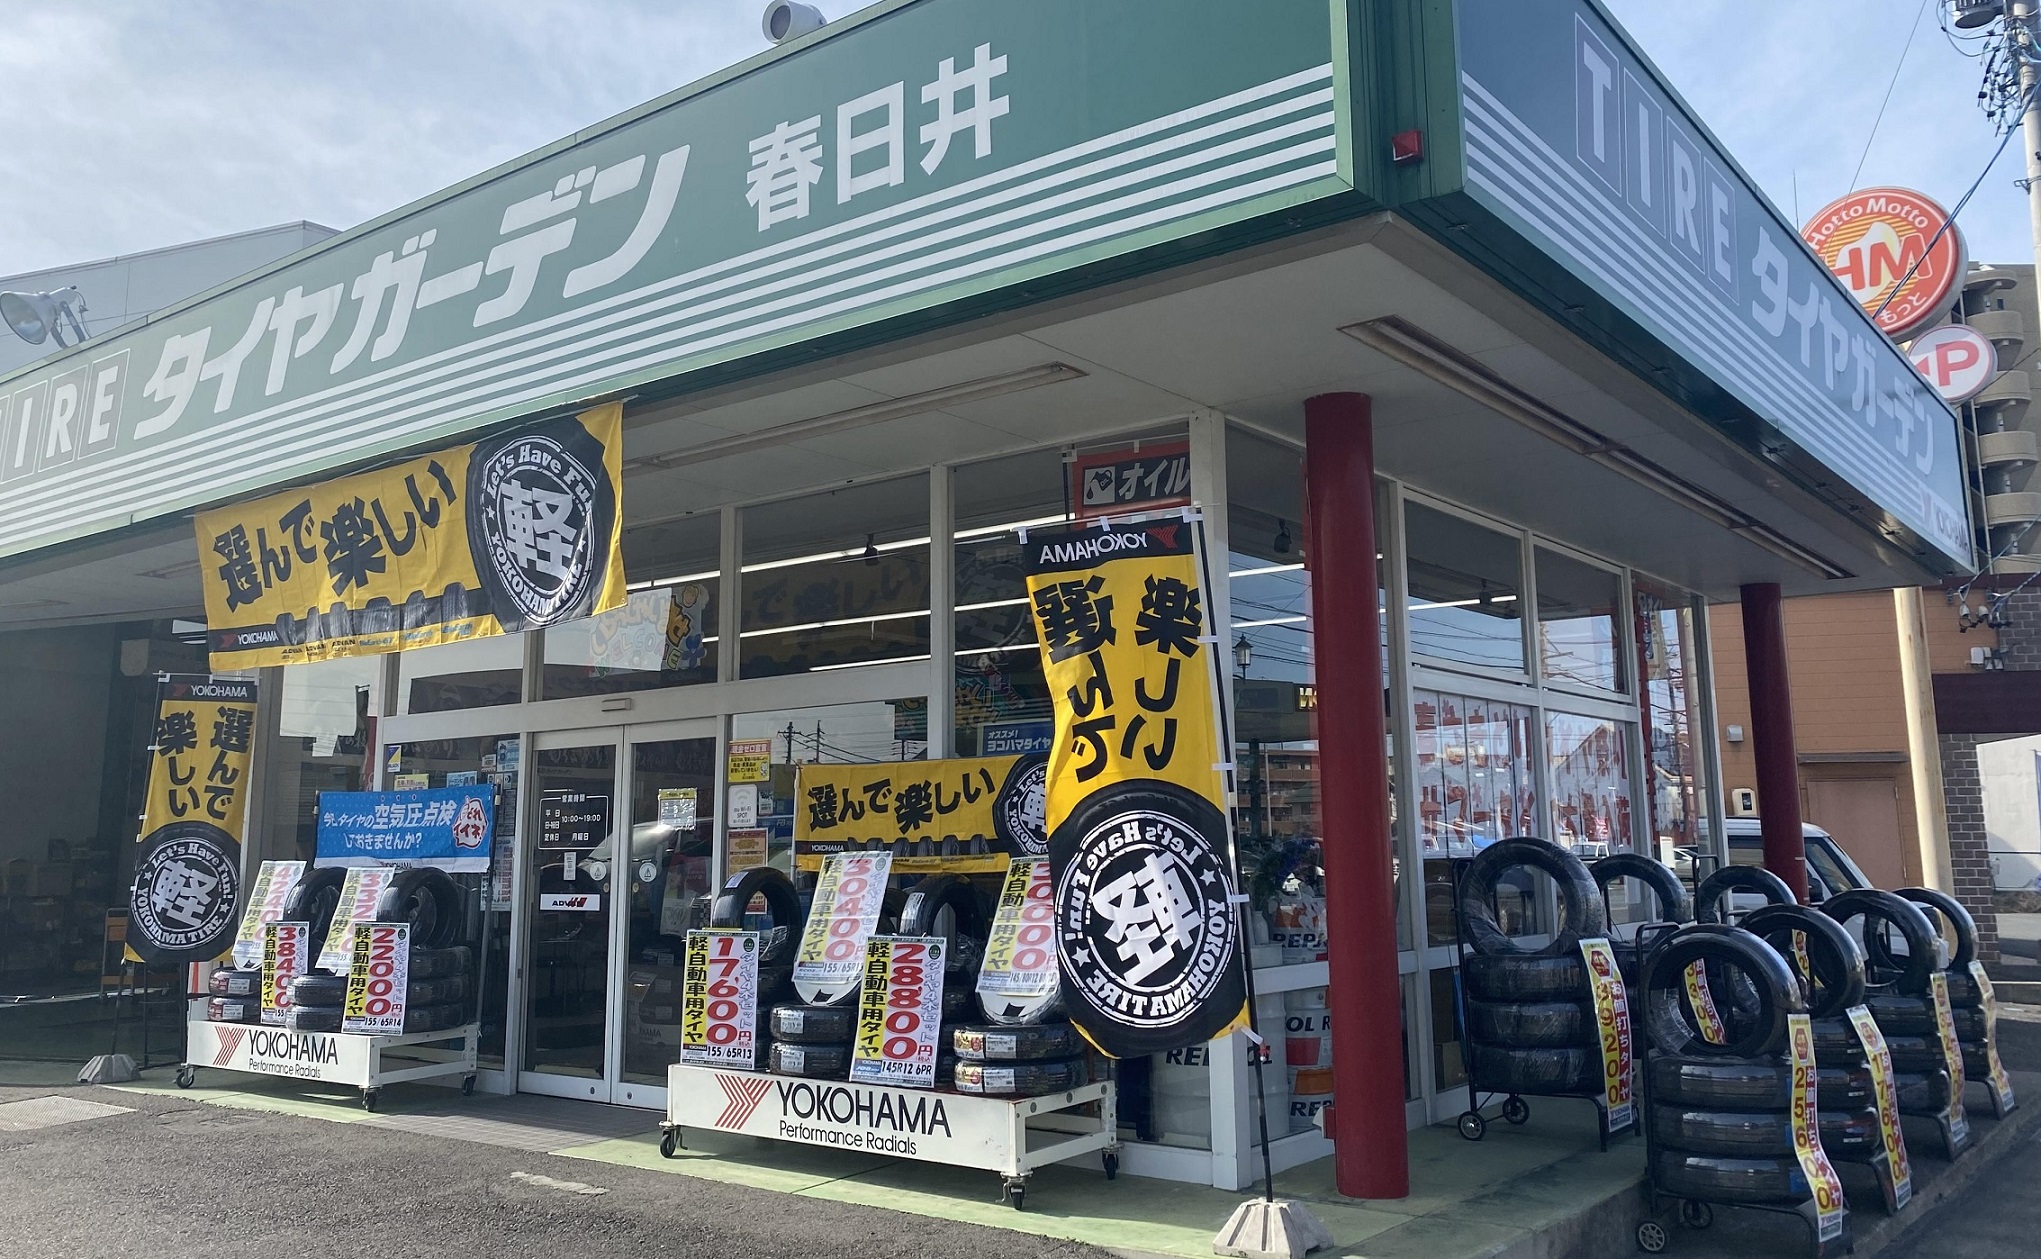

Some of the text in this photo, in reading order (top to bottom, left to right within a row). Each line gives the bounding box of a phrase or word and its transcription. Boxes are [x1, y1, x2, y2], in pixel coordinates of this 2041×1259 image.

[1807, 197, 1929, 251] Hotto Motto
[0, 43, 1011, 469] IRE タイヤガーデン 春日井
[1583, 40, 1934, 476] TIRE タイヤガーデン
[1935, 339, 1980, 388] P
[487, 444, 595, 503] Let's Have Fu
[1118, 456, 1191, 500] オイル
[211, 458, 458, 614] 選んで楽しい
[500, 478, 578, 581] 軽
[237, 630, 279, 645] YOKOHAMA
[190, 684, 248, 698] YOKOHAMA
[156, 709, 200, 818] 楽しい
[203, 706, 255, 820] 選んで
[987, 738, 1052, 752] ヨコハマタイヤ
[807, 767, 996, 835] 選んで楽しい
[152, 842, 234, 899] Let's Have Fun!
[811, 844, 845, 852] YOKOHAMA
[137, 887, 223, 944] YOKOHAMA TIRE
[150, 859, 219, 928] 軽
[803, 857, 842, 961] 軽自動車用タイヤ
[988, 862, 1031, 970] 軽自動車用タイヤ
[263, 926, 277, 1007] 軽自動車用タイヤ
[347, 927, 371, 1015] 軽自動車用タイヤ
[684, 936, 709, 1043] 軽自動車用タイヤ
[859, 942, 890, 1058] 軽自動車用タイヤ
[248, 1029, 339, 1065] YOKOHAMA
[707, 1046, 752, 1059] 155/65R13
[738, 1030, 752, 1042] 円
[918, 1044, 933, 1056] 円
[1610, 982, 1630, 1101] お値打ちタイヤ
[248, 1058, 321, 1079] Performance Radials
[881, 1061, 932, 1075] 145R12 6PR
[776, 1080, 952, 1138] YOKOHAMA
[779, 1119, 917, 1155] Performance Radials
